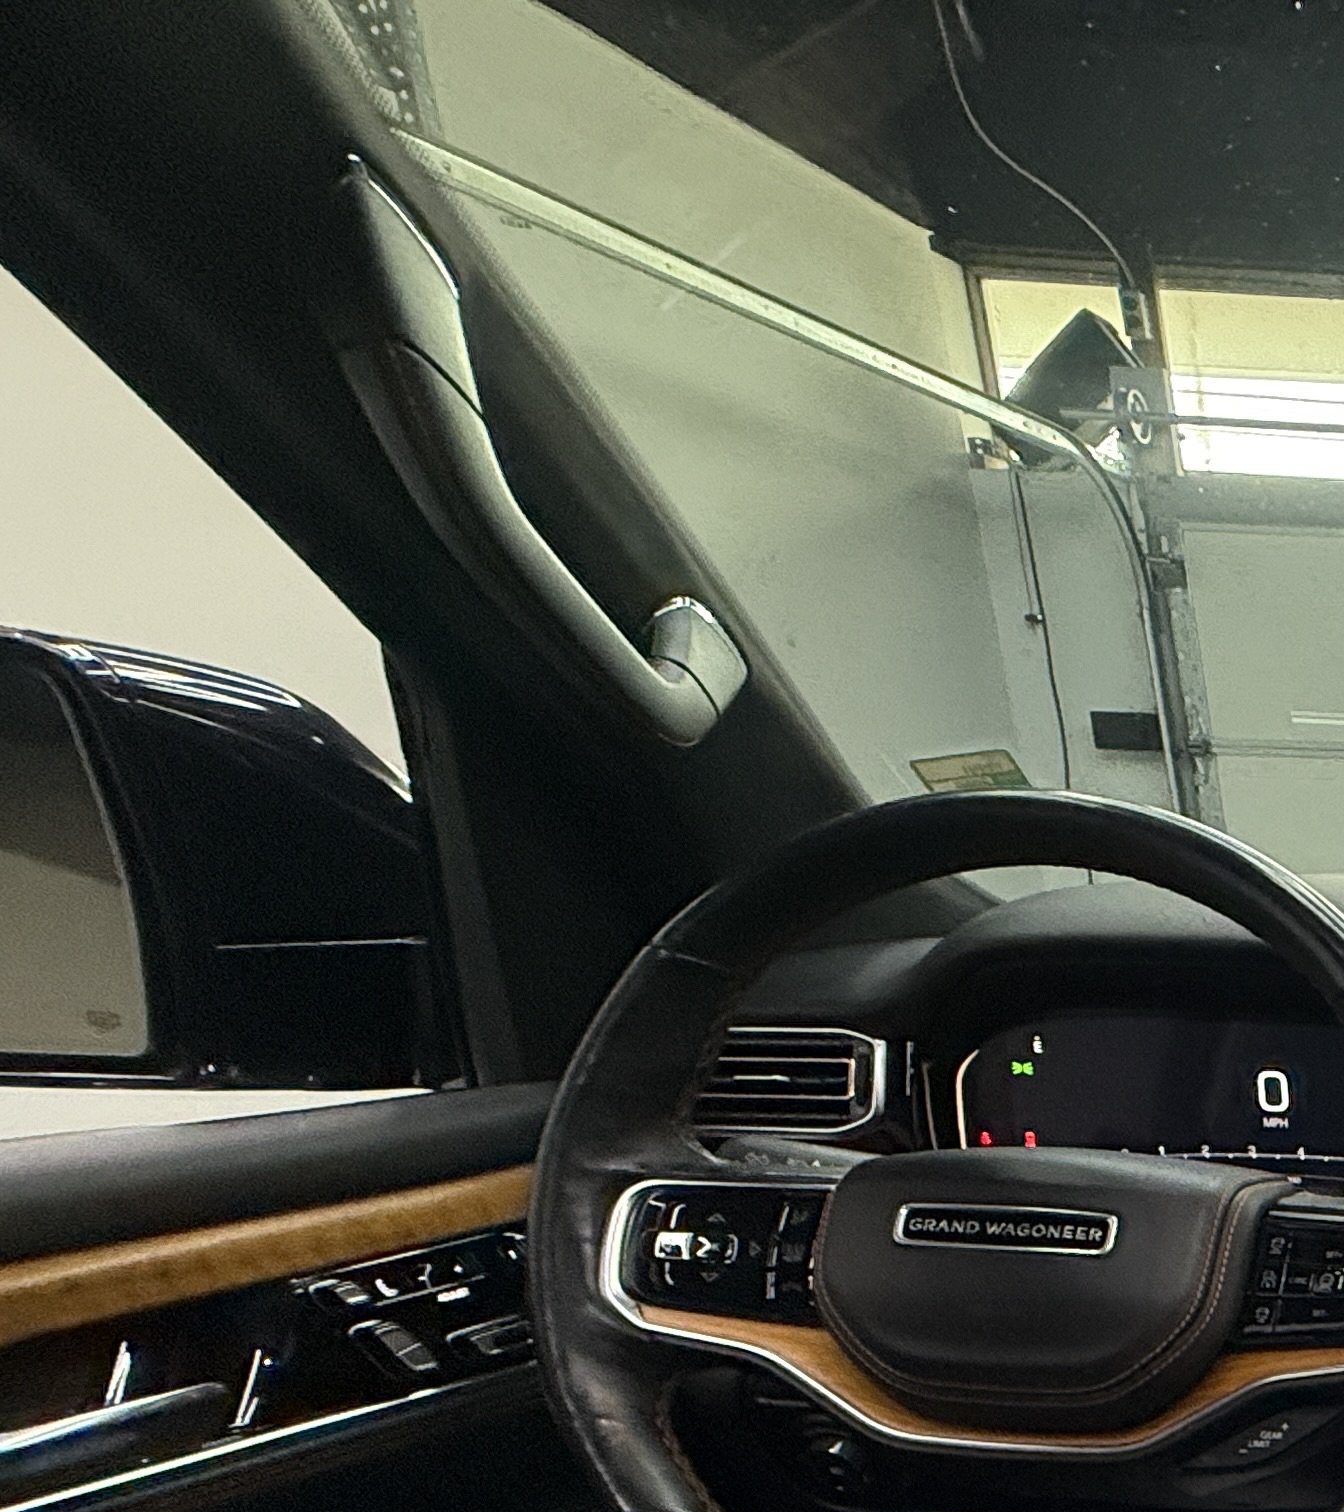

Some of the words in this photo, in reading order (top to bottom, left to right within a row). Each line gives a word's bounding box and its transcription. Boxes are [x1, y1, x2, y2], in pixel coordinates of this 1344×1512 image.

[1257, 1070, 1289, 1112] 0
[1262, 1117, 1289, 1129] MPH
[909, 1217, 980, 1234] GRAND
[985, 1221, 1103, 1242] WAGONEER
[1260, 1430, 1283, 1440] GEAR
